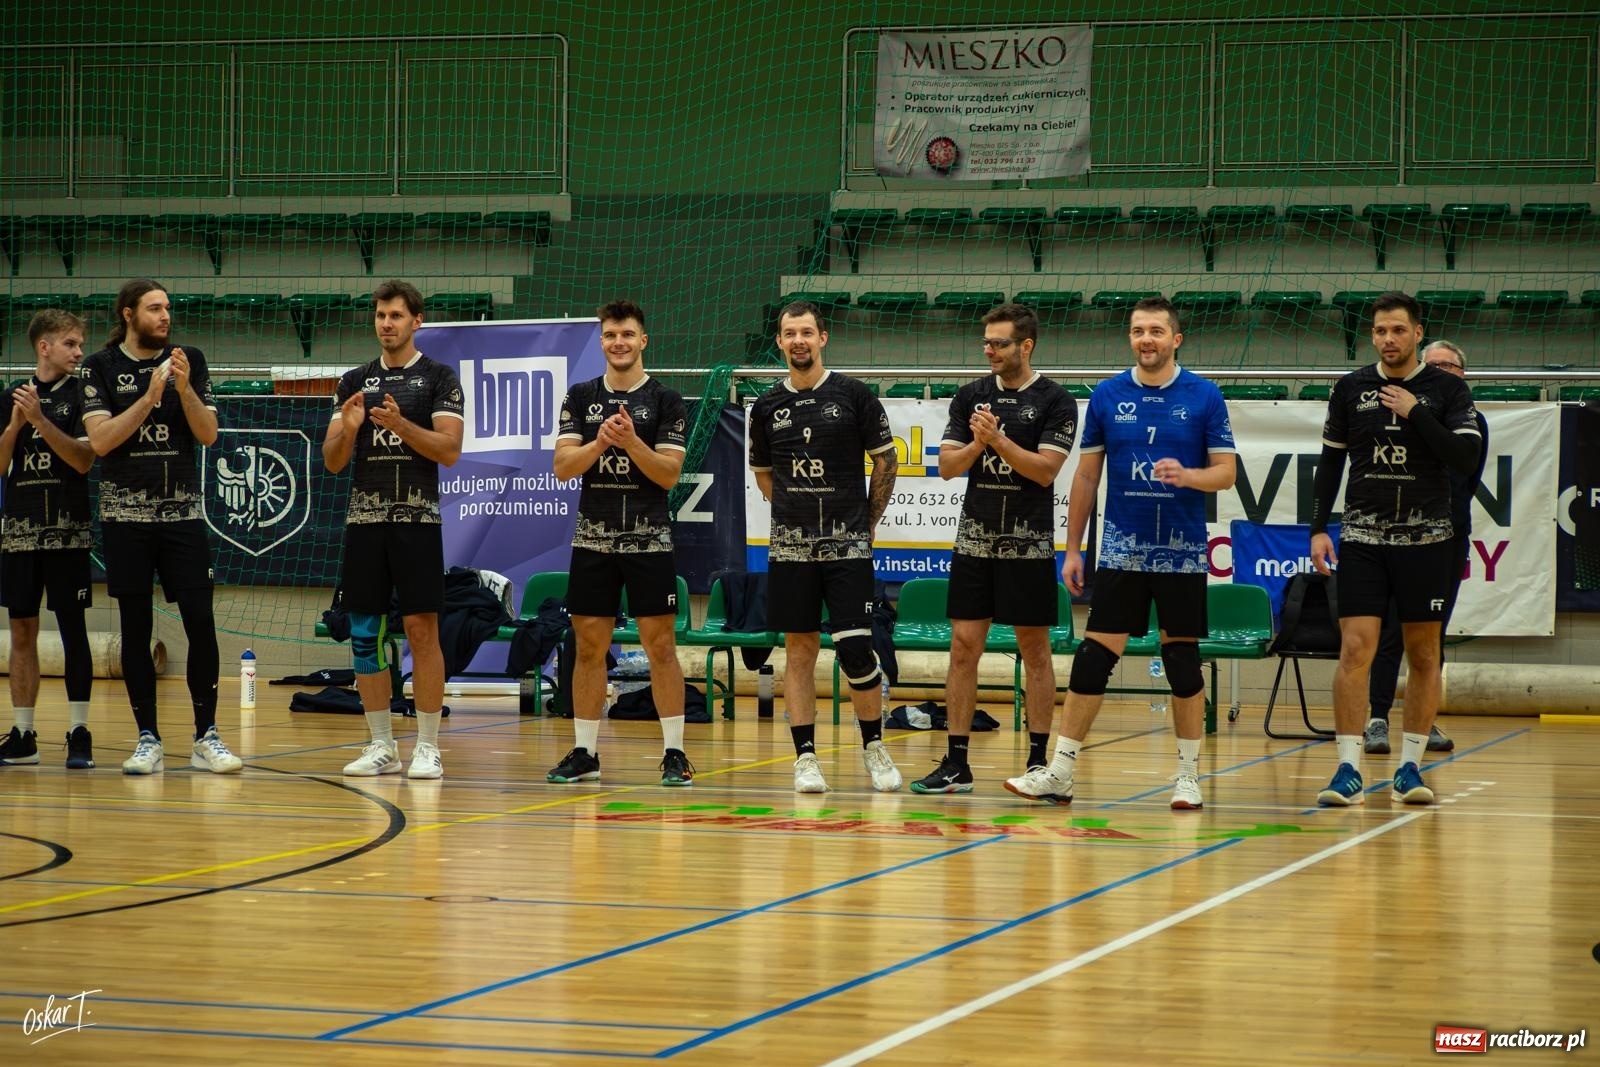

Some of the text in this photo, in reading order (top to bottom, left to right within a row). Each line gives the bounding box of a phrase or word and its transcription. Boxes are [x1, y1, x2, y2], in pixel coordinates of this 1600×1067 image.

[903, 34, 1068, 72] MIESZKO
[904, 87, 1087, 104] Operator urządzeń cukierniczych
[904, 103, 1035, 116] Pracownik produkcyjny
[969, 119, 1076, 133] Czekamy na Ciebie!
[115, 383, 138, 393] radlin
[1114, 413, 1138, 422] radlin
[802, 426, 812, 444] 9
[1146, 426, 1157, 445] 7
[791, 459, 825, 478] KB
[438, 476, 508, 497] udujemy
[919, 492, 945, 506] 632
[459, 498, 569, 521] porozumienia
[895, 512, 912, 526] ul.
[930, 516, 957, 527] von
